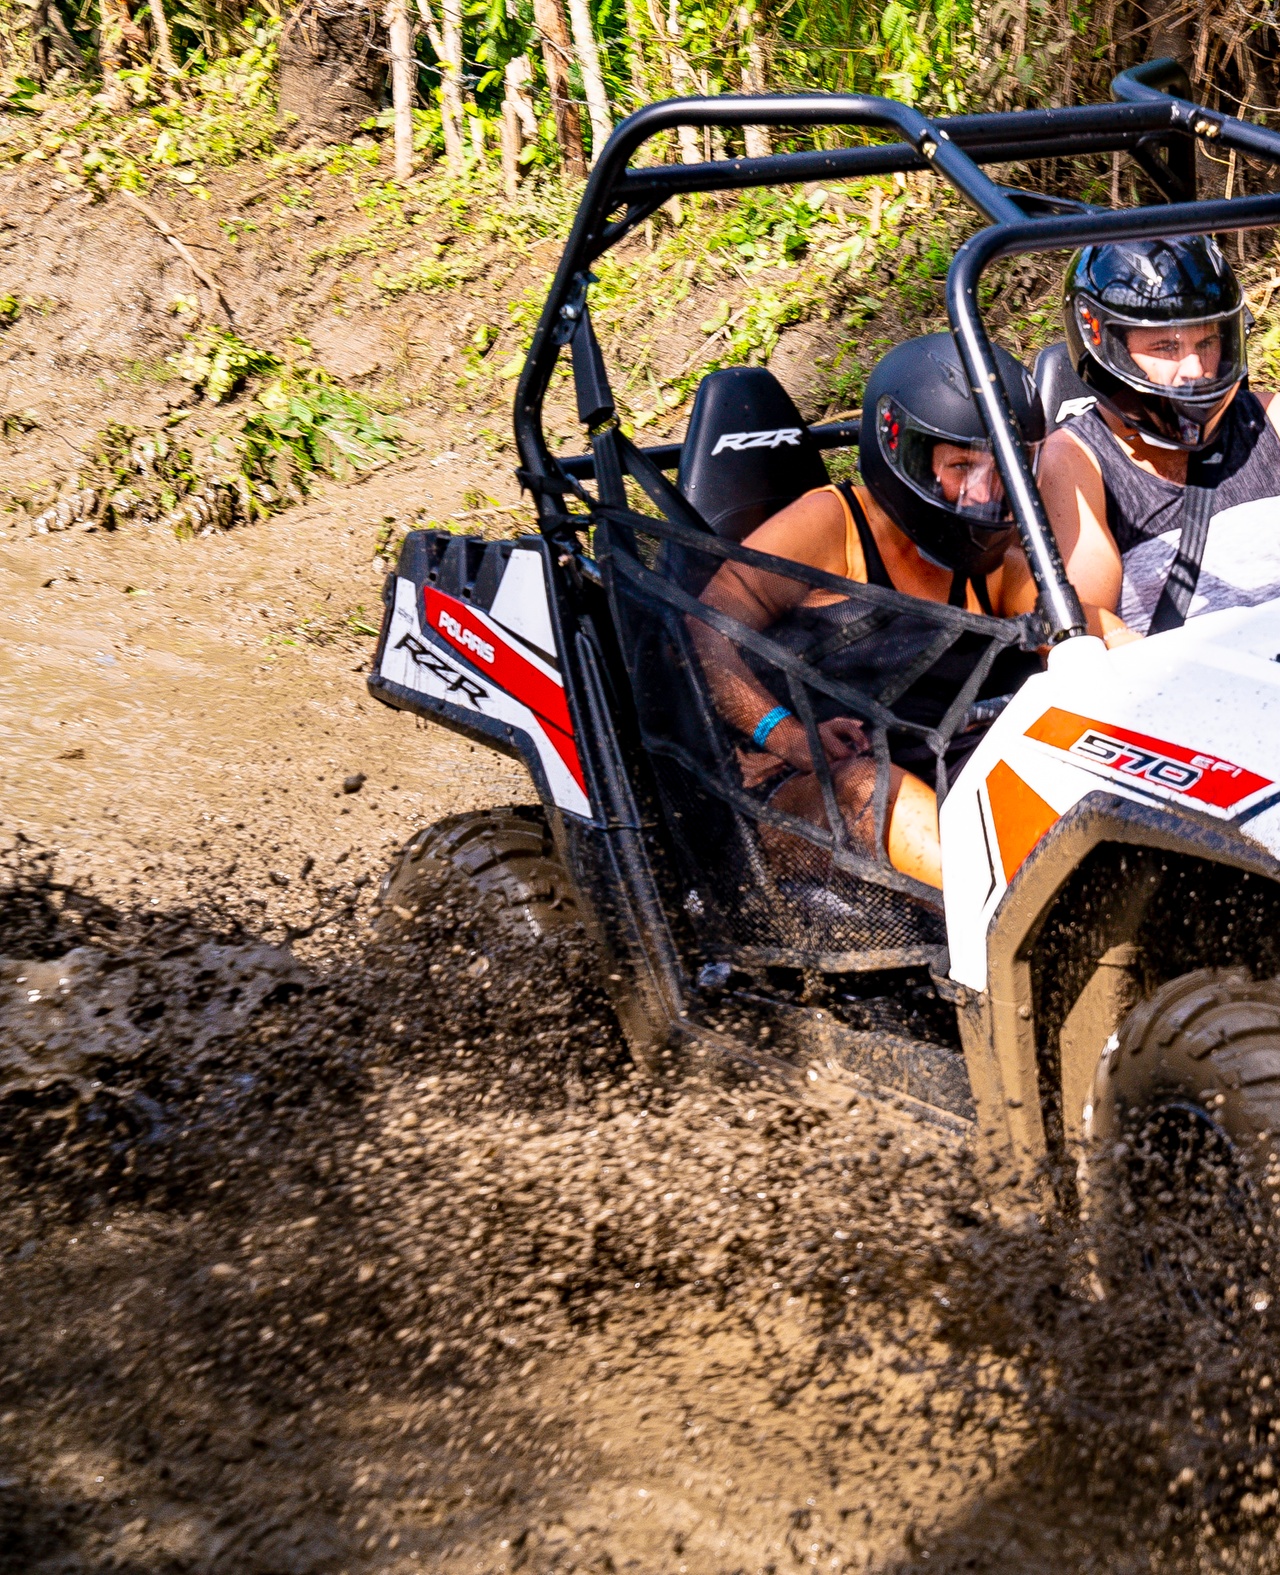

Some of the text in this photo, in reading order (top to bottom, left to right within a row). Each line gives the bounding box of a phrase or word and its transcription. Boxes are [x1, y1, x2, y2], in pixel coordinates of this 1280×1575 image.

[711, 428, 803, 456] RZR
[438, 610, 495, 664] POLARIS
[394, 633, 490, 710] RZR
[1070, 729, 1243, 791] 570 EFI
